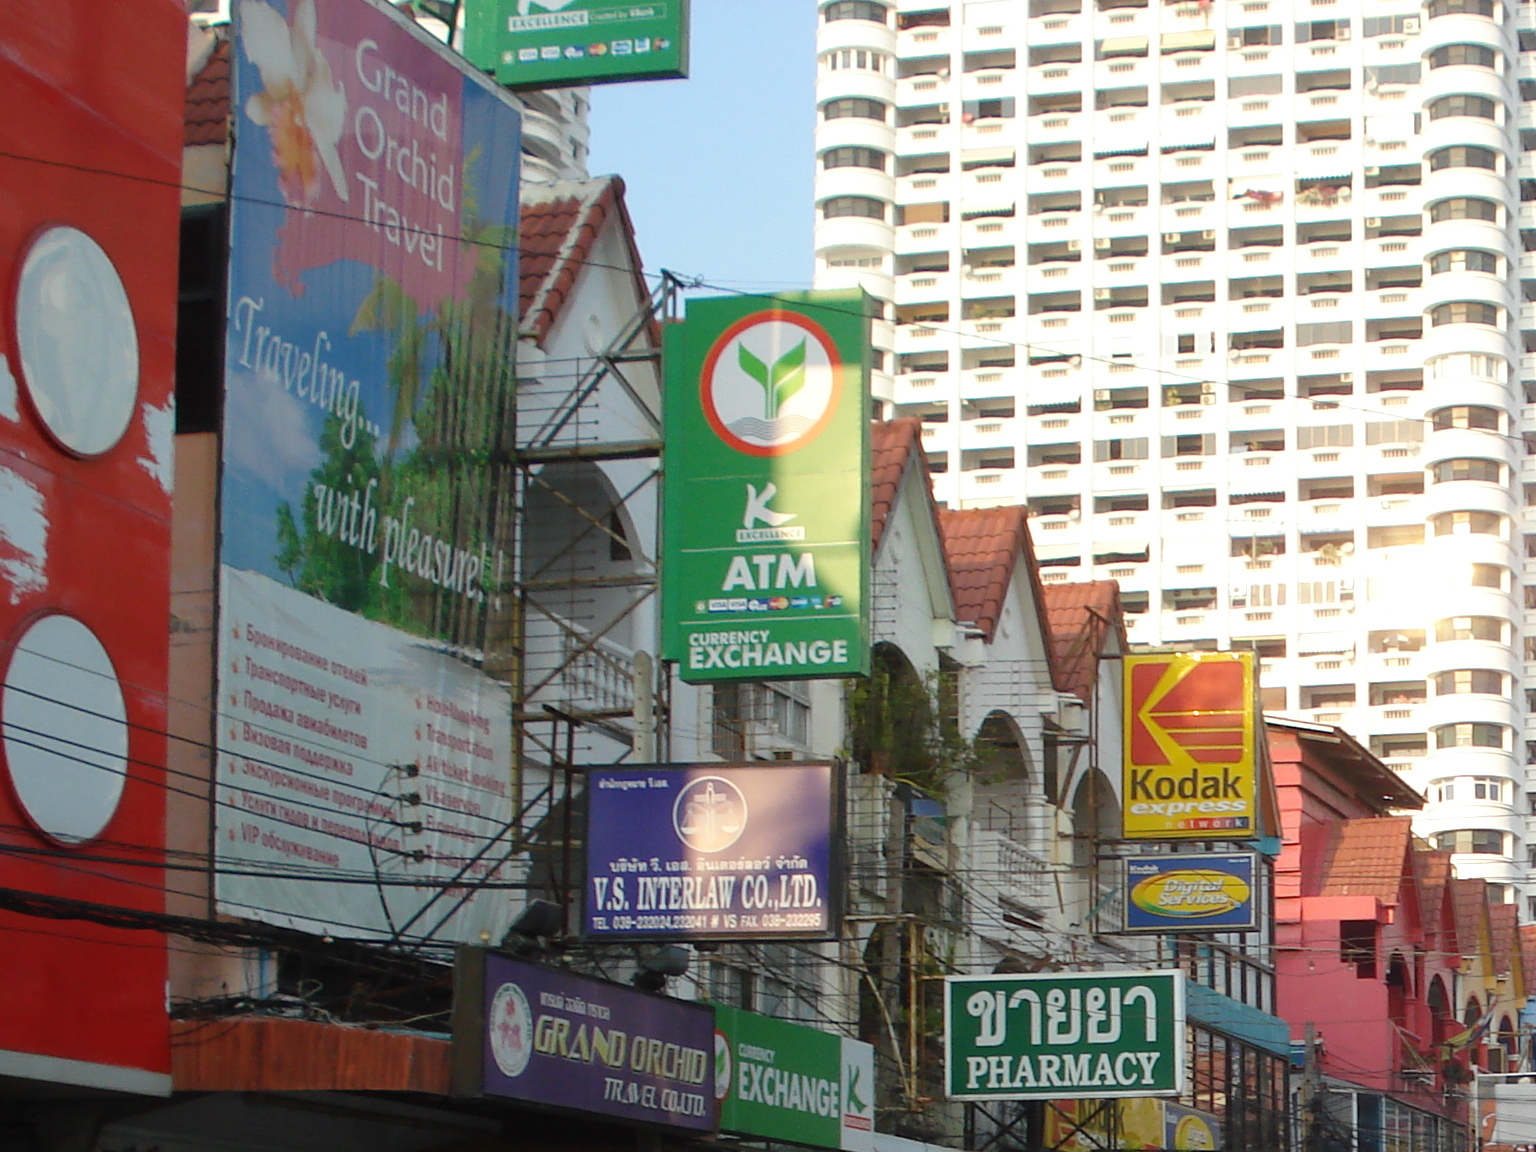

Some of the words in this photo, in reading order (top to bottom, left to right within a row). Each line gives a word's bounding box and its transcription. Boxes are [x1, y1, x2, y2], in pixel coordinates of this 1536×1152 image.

[512, 14, 586, 28] EXCELLENCE
[356, 39, 447, 141] Grand
[355, 106, 454, 213] Orchid
[356, 172, 442, 271] Travel
[235, 296, 379, 449] Traveling...
[314, 474, 377, 554] with
[740, 529, 801, 540] EXCELLENCE
[722, 552, 817, 591] ATM
[689, 630, 770, 646] CURRENCY
[690, 639, 848, 669] EXCHANGE
[1130, 767, 1243, 800] Kodak
[1130, 800, 1248, 817] express
[1165, 818, 1244, 829] network
[241, 822, 260, 844] VIP
[593, 877, 630, 911] V.S.
[637, 875, 736, 911] INTERLAW
[1158, 892, 1229, 906] Services
[1164, 879, 1224, 895] Digital
[966, 985, 1157, 1046] ขายยา
[535, 1015, 626, 1069] GRAND
[631, 1035, 708, 1086] ORCHID
[966, 1051, 1161, 1089] PHARMACY
[604, 1077, 658, 1109] TRAVEL
[738, 1061, 839, 1118] EXCHANGE
